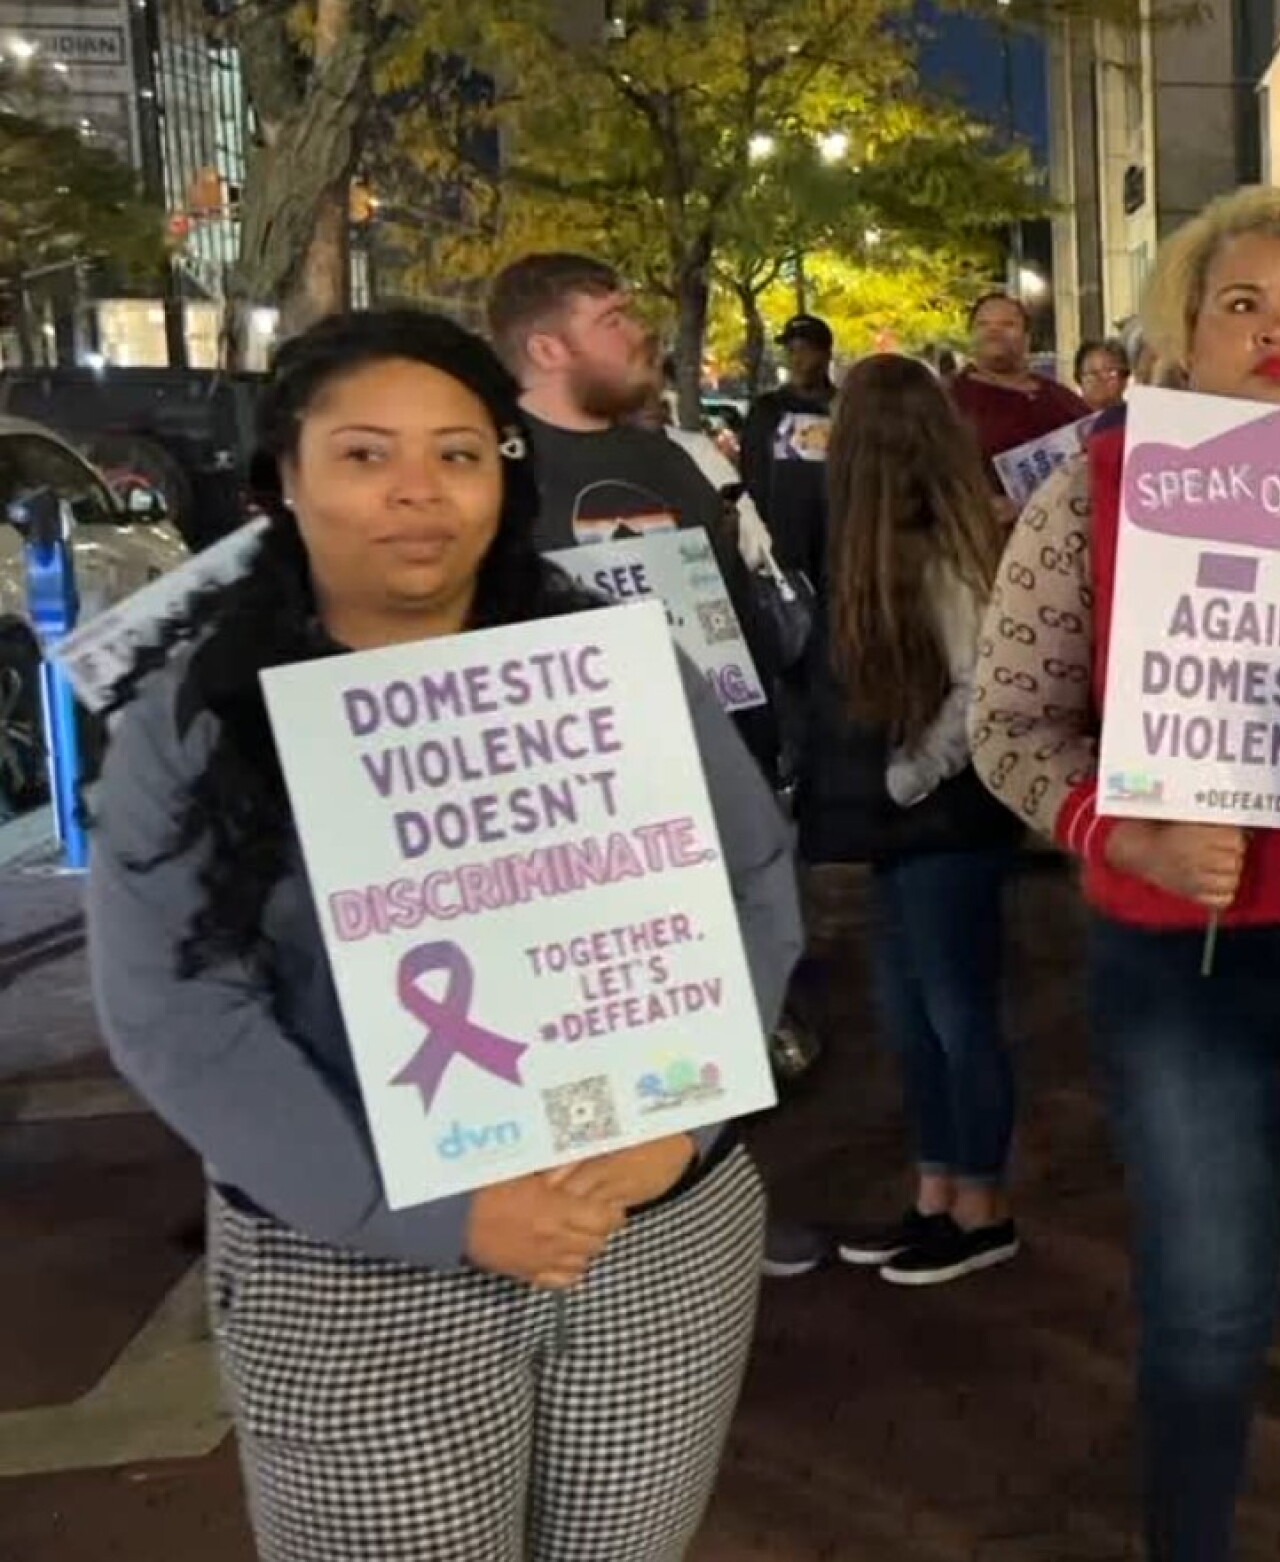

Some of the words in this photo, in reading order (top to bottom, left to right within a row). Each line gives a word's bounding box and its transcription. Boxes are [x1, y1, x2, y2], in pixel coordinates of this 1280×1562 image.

[1136, 464, 1253, 508] SPEAK
[594, 564, 652, 597] SEE
[341, 645, 610, 737] DOMESTIC
[361, 706, 623, 798] VIOLENCE
[394, 770, 618, 859] DOESN'T
[329, 816, 717, 942] DISCRIMINATE.
[580, 955, 669, 1000] LET'S
[437, 1119, 521, 1161] dvn
